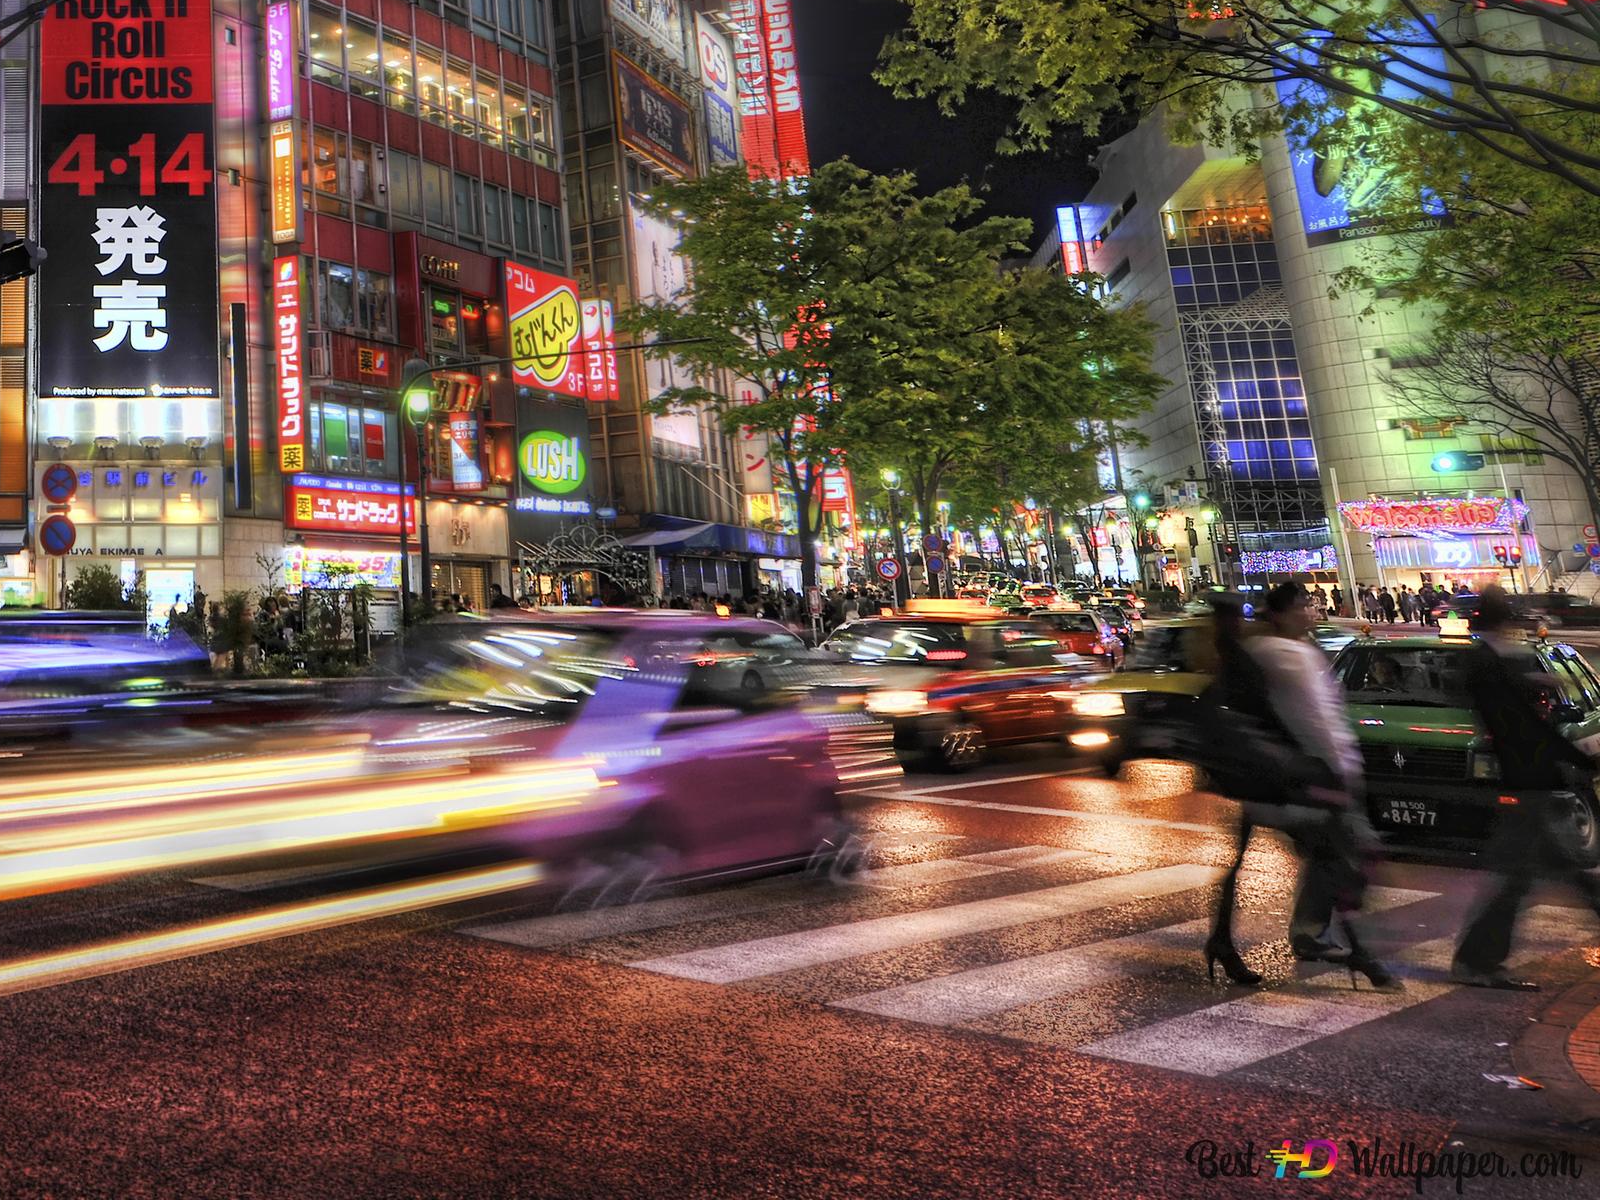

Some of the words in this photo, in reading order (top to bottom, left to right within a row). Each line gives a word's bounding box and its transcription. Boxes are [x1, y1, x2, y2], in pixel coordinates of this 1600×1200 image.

[269, 2, 288, 18] 5F
[91, 21, 166, 60] Roll
[65, 60, 193, 101] Circus
[91, 204, 168, 353] 発売
[360, 349, 373, 373] 薬
[53, 387, 86, 396] Produced
[87, 387, 96, 397] by
[97, 388, 112, 396] max
[112, 387, 146, 396] matsuura
[568, 373, 585, 393] 3F
[283, 447, 302, 471] 薬
[527, 437, 579, 482] LUSH
[78, 469, 208, 487] 谷駅前ビル
[297, 495, 312, 519] 薬
[1351, 504, 1456, 529] Welcome
[100, 548, 145, 556] EKIMAE
[155, 548, 164, 556] A
[1391, 808, 1437, 826] 84-77
[1408, 801, 1425, 810] 500
